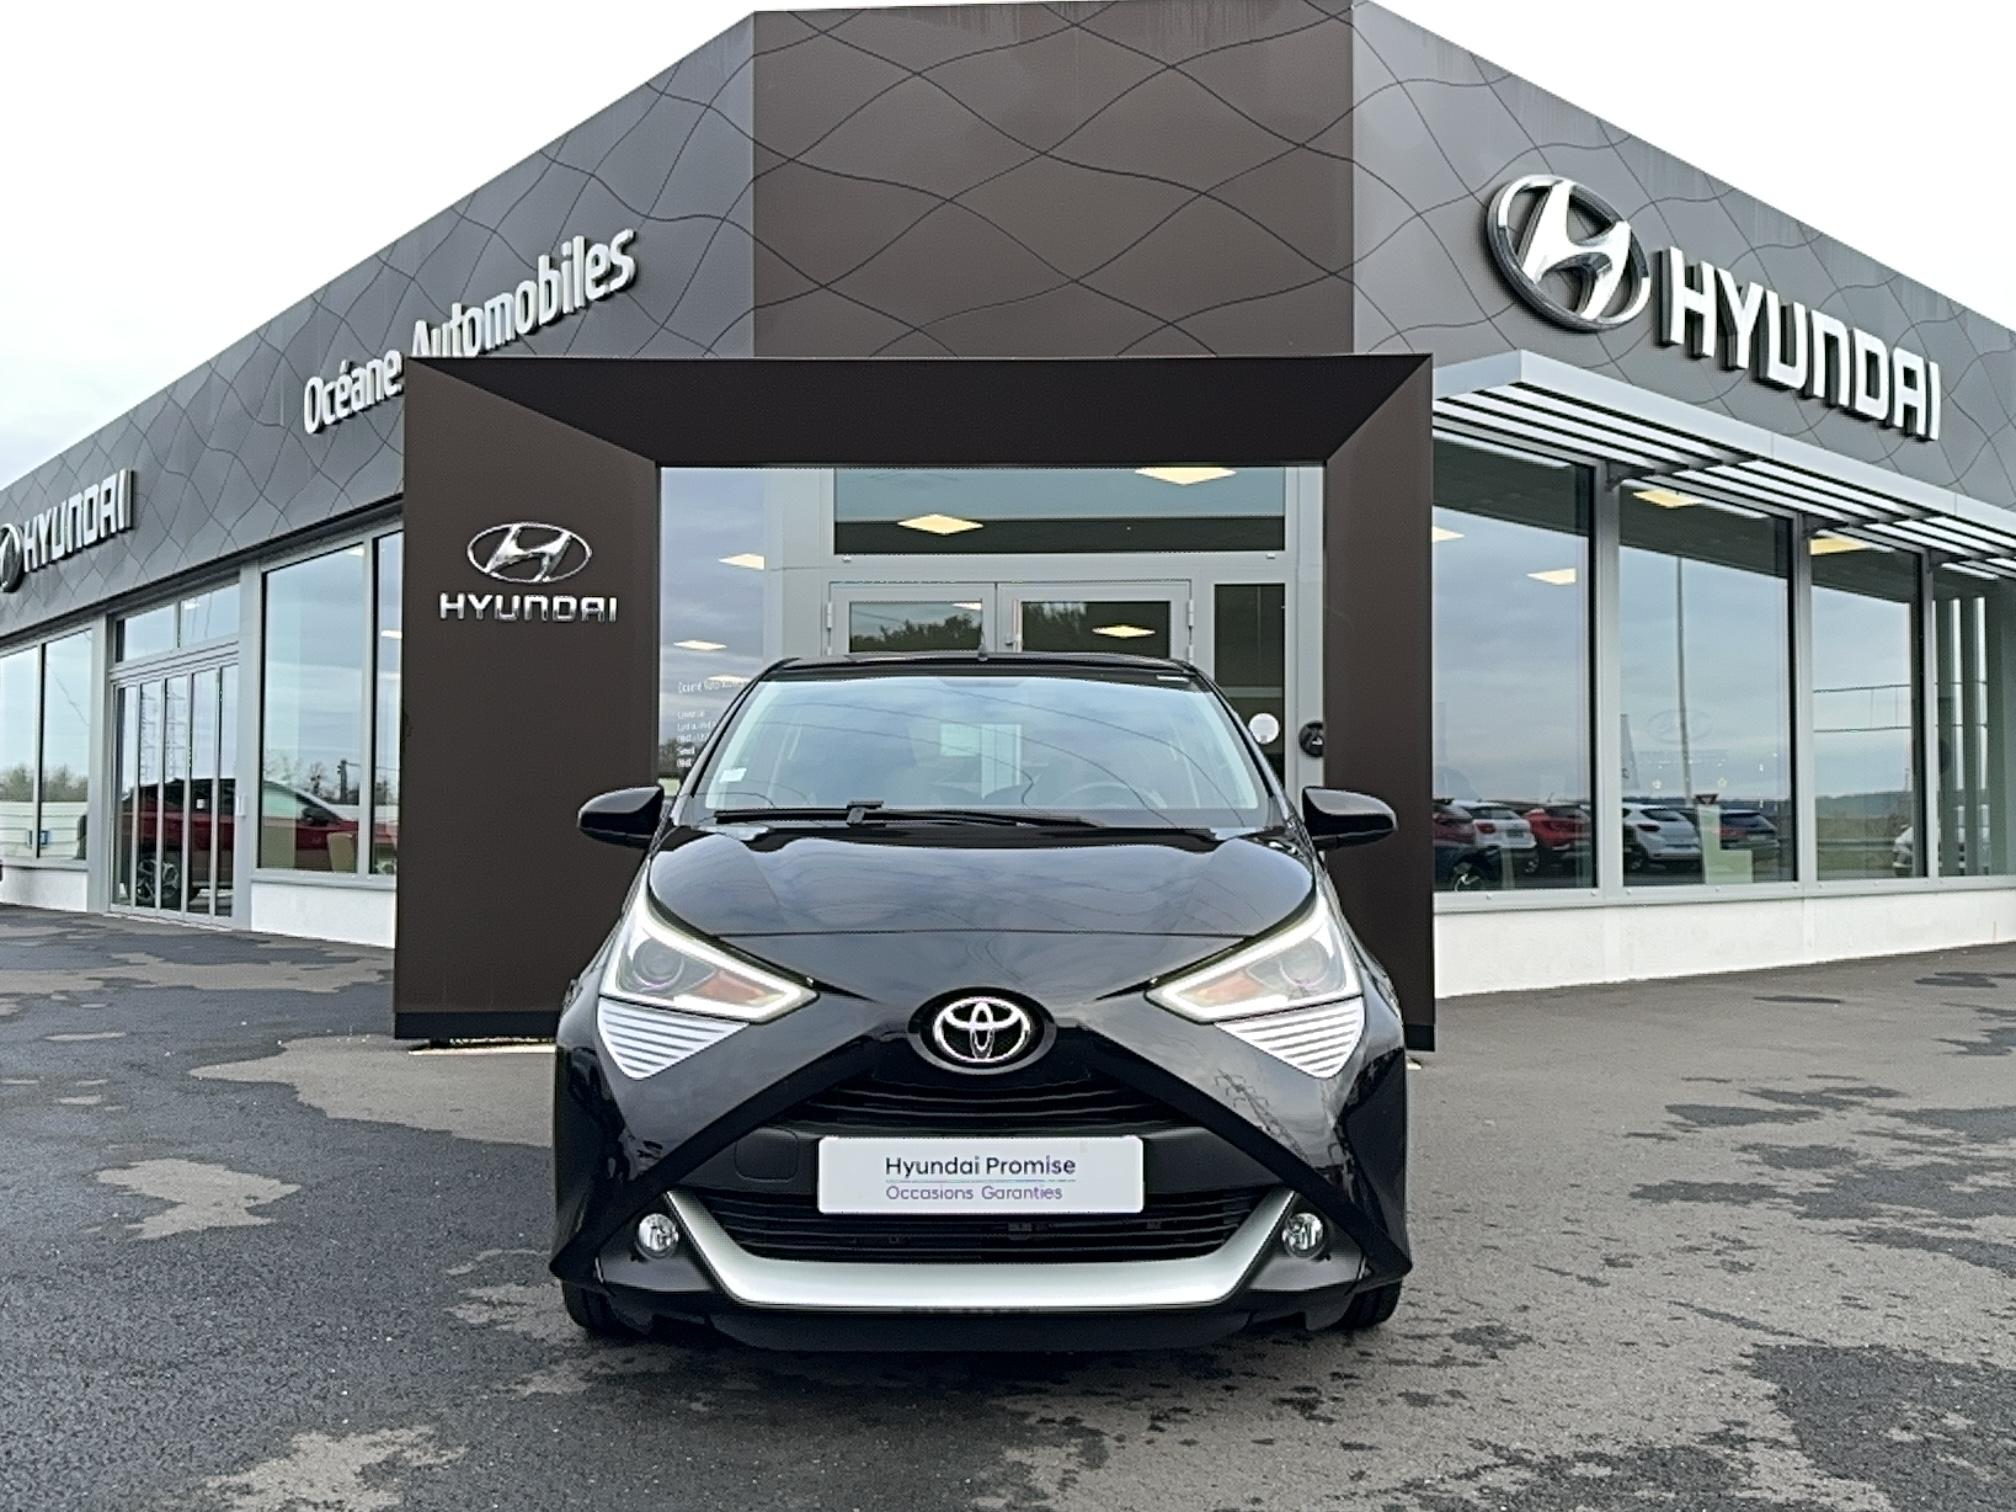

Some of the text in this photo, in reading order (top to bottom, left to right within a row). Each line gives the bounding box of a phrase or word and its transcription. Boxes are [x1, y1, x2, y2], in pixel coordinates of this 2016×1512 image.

[303, 228, 637, 435] Océane Automobiles
[1666, 246, 1941, 441] HYUNDAI
[23, 468, 130, 573] HYUNDAI
[439, 593, 618, 622] HYUNDAI
[885, 1156, 1076, 1178] Hyundai Promise
[886, 1185, 1063, 1200] Occasions Garanties
